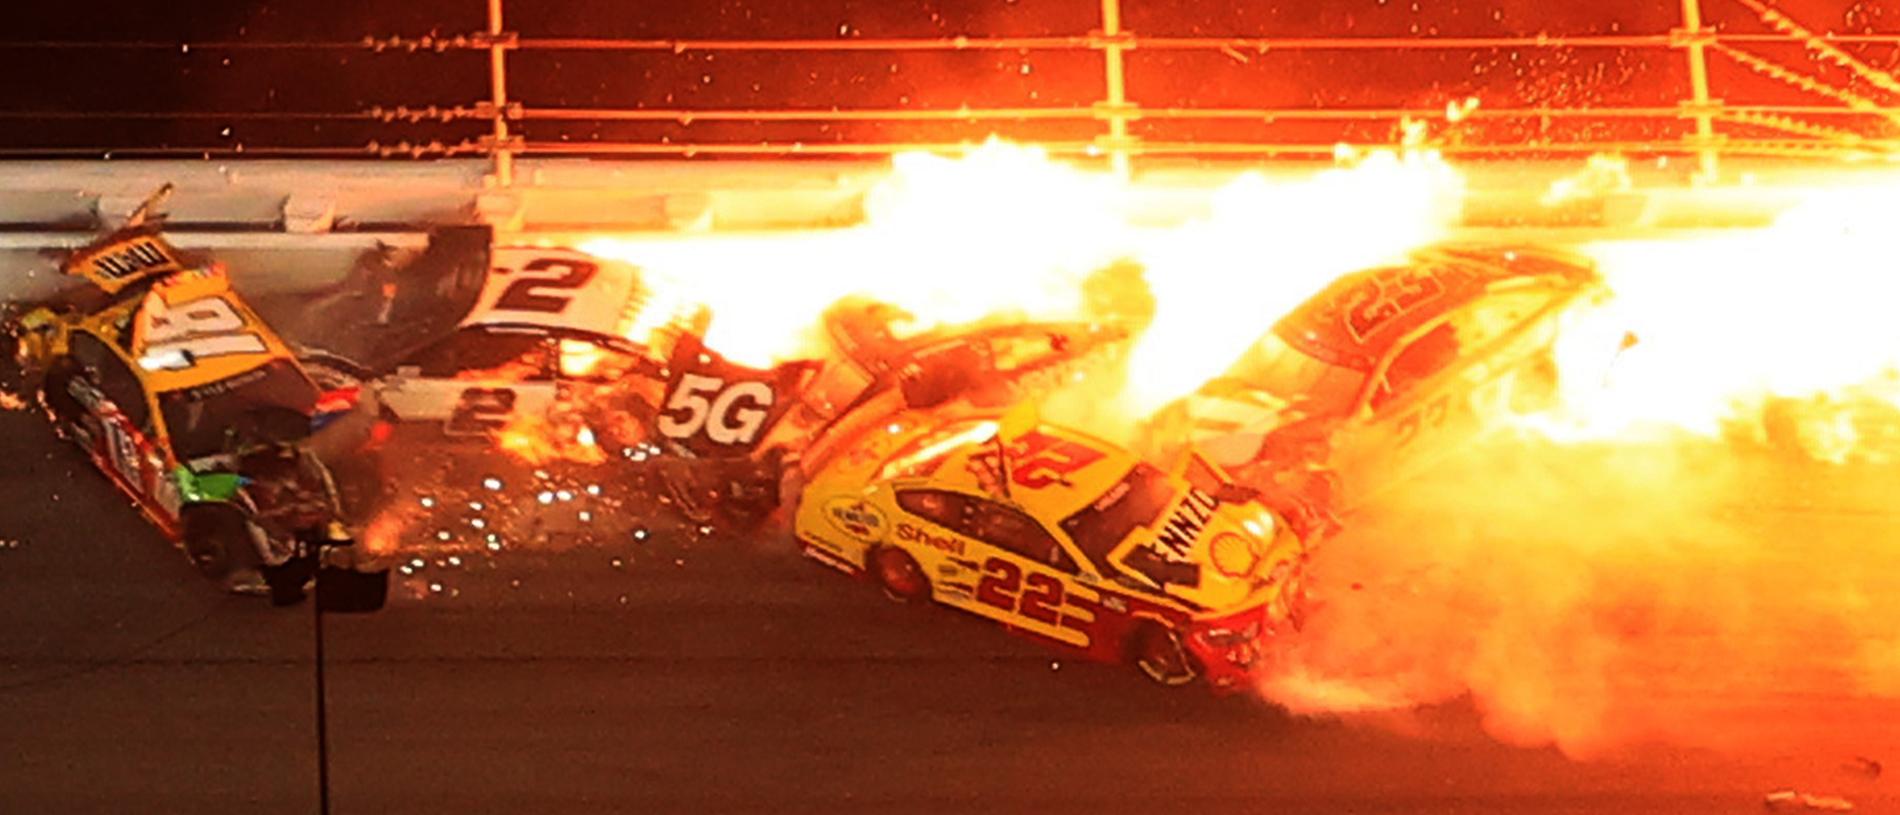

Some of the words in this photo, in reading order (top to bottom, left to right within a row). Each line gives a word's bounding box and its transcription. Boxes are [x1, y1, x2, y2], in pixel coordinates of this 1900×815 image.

[493, 258, 599, 313] 2
[450, 388, 516, 434] 2
[658, 373, 773, 444] 5G
[896, 523, 966, 556] Shell
[977, 557, 1063, 627] 22
